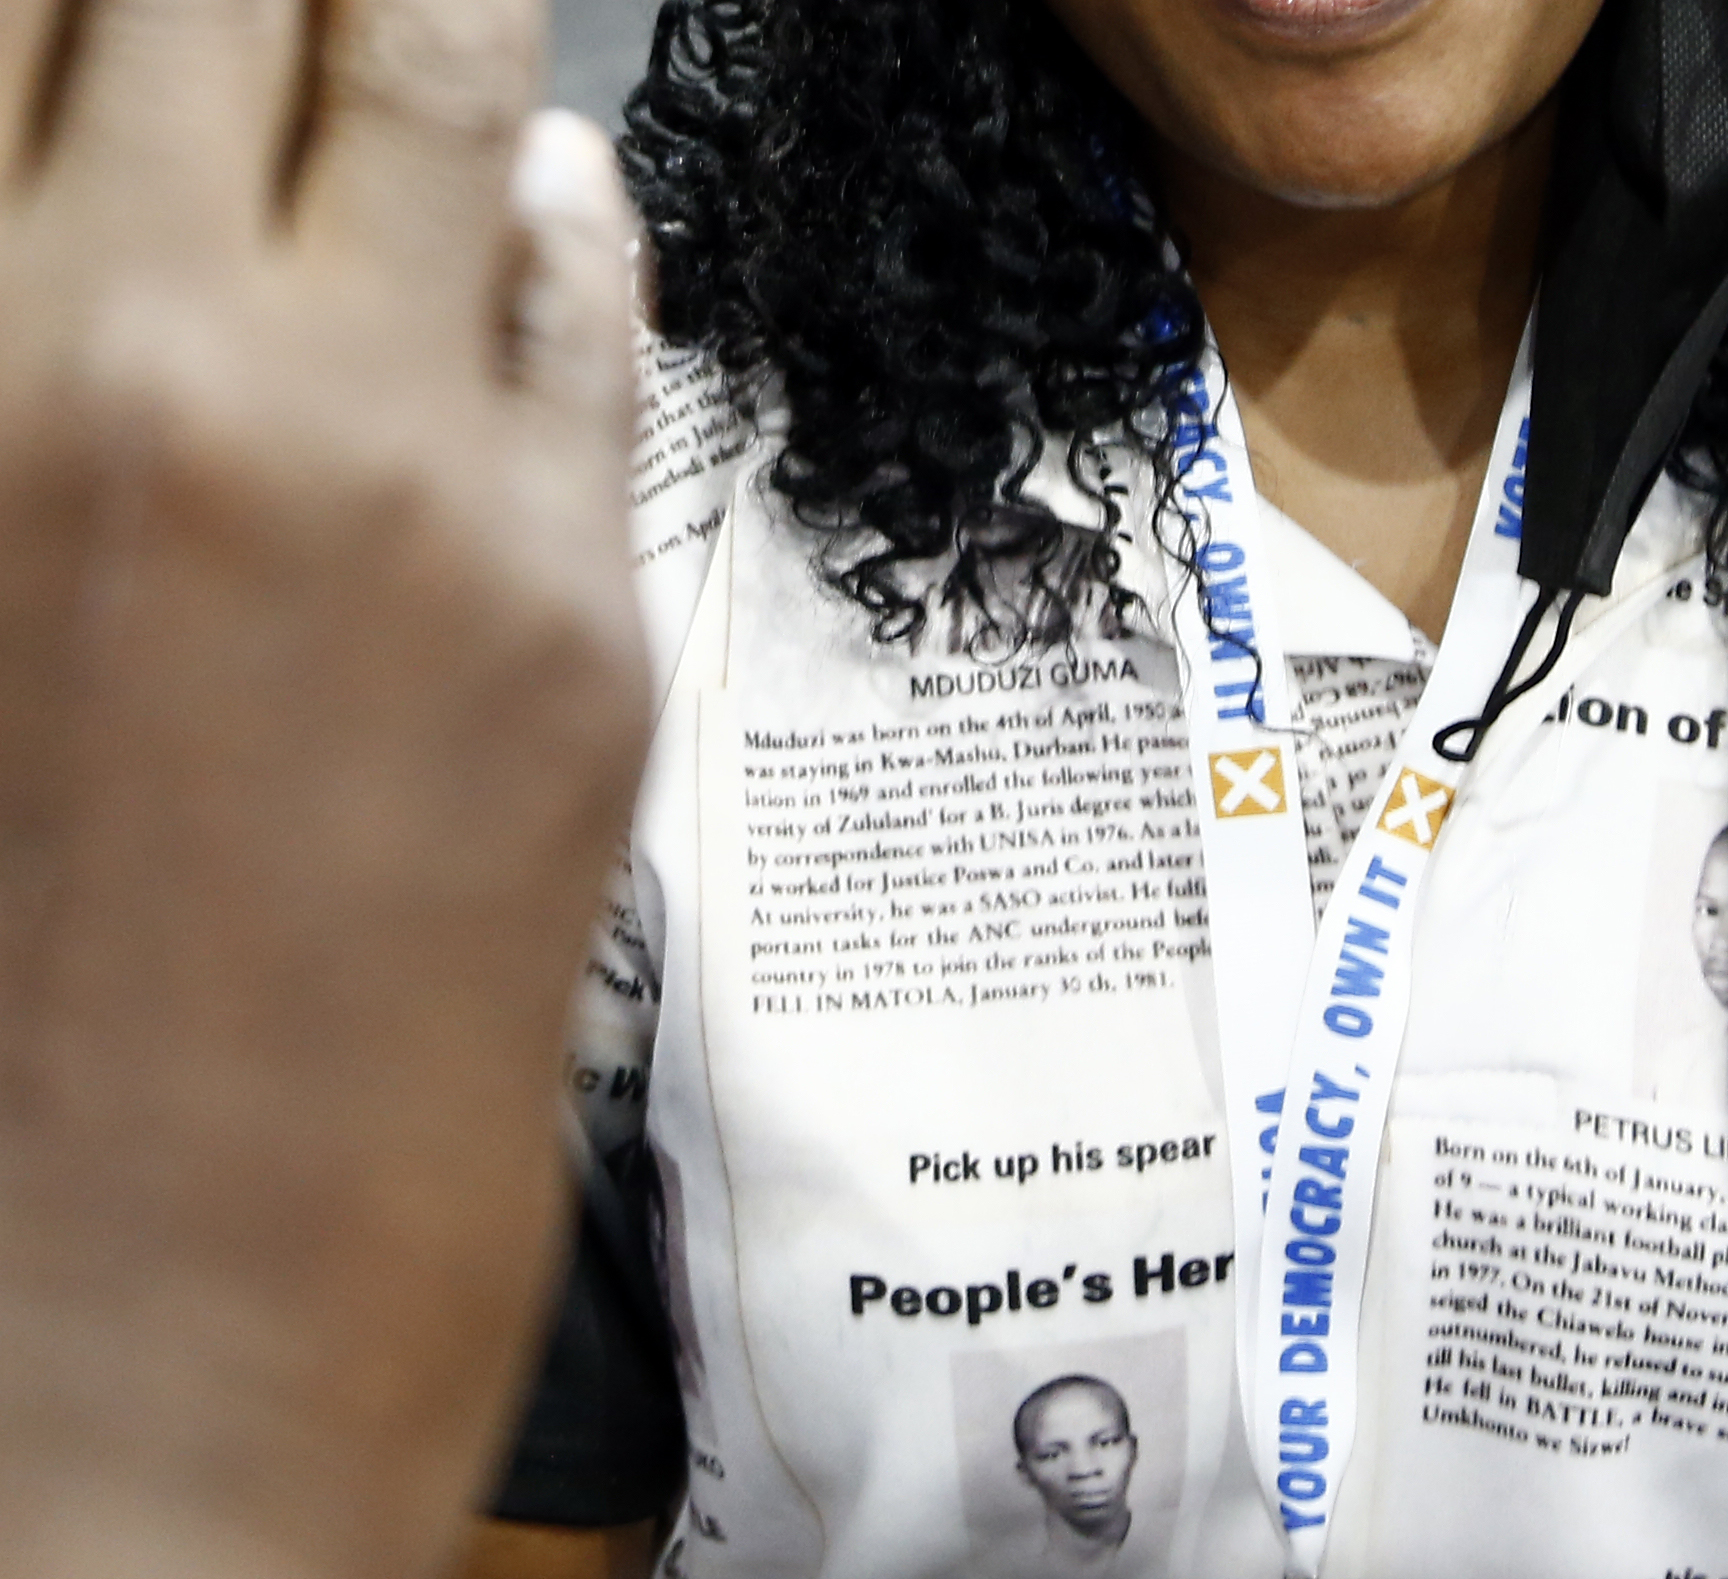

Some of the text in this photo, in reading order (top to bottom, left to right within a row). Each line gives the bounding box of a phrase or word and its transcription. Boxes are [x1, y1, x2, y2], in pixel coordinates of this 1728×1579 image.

[1194, 542, 1255, 662] OWN
[910, 659, 1139, 701] MDUDUZI GUMA
[1212, 681, 1266, 724] IT
[744, 701, 1115, 750] Mduduzi was born on the 4th of April,
[1668, 708, 1728, 750] of
[744, 732, 1131, 784] was staying in Kwa-Mashu, He
[744, 788, 795, 808] lation
[804, 789, 821, 807] in
[877, 779, 913, 801] and
[918, 772, 997, 797] enrolled
[1004, 770, 1034, 789] the
[1042, 763, 1134, 786] following
[1140, 765, 1180, 783] year
[748, 817, 807, 843] versity
[813, 815, 831, 837] of
[939, 808, 966, 826] for
[974, 809, 984, 822] a
[1017, 799, 1064, 823] Juris
[1070, 795, 1131, 817] degree
[747, 845, 767, 870] by
[774, 839, 924, 870] correspondence
[931, 833, 974, 857] with
[980, 829, 1055, 852] UNISA
[1061, 825, 1079, 845] in
[1140, 821, 1165, 840] As
[1172, 825, 1181, 838] a
[749, 876, 764, 896] zi
[771, 873, 840, 896] worked
[846, 872, 875, 892] for
[881, 868, 947, 896] Justice
[1022, 856, 1058, 878] and
[1107, 849, 1143, 871] and
[1148, 849, 1193, 868] later
[751, 906, 772, 926] At
[780, 901, 884, 926] university,
[890, 899, 913, 918] he
[921, 902, 957, 916] was
[964, 902, 973, 914] a
[979, 889, 1041, 911] SASO
[1131, 880, 1161, 901] He
[750, 909, 1166, 961] portant tasks for the ANC underground
[751, 969, 826, 988] country
[836, 963, 854, 982] in
[913, 962, 934, 976] to
[941, 954, 977, 978] join
[985, 952, 1016, 971] the
[1024, 946, 1078, 968] ranks
[1086, 944, 1105, 961] of
[1113, 940, 1144, 960] the
[817, 991, 843, 1013] IN
[851, 987, 964, 1009] MATOLA,
[970, 981, 1051, 1007] January
[1574, 1108, 1693, 1154] PETRUS
[908, 1131, 1216, 1185] Pick up his spear
[1434, 1135, 1485, 1162] Born
[1492, 1149, 1518, 1165] on
[1526, 1146, 1557, 1171] the
[1604, 1163, 1626, 1184] of
[1633, 1166, 1726, 1205] January,
[1277, 852, 1407, 1534] YOUR DEMOCRACY, OWN IT
[1434, 1169, 1454, 1188] of
[1509, 1184, 1519, 1197] a
[1527, 1182, 1595, 1210] typical
[1604, 1199, 1693, 1234] working
[1432, 1227, 1503, 1257] church
[1509, 1245, 1527, 1261] at
[1534, 1244, 1566, 1267] the
[1572, 1250, 1647, 1277] Jabavu
[1433, 1198, 1463, 1219] He
[1471, 1209, 1507, 1227] was
[1516, 1214, 1526, 1229] a
[1533, 1211, 1615, 1247] brilliant
[1624, 1229, 1705, 1262] football
[849, 1262, 1114, 1327] People's
[1431, 1260, 1449, 1280] in
[1512, 1271, 1544, 1295] On
[1552, 1279, 1585, 1302] the
[1638, 1296, 1659, 1316] of
[1497, 1299, 1527, 1320] the
[1459, 1347, 1486, 1371] his
[1574, 1343, 1598, 1366] he
[1681, 1362, 1703, 1378] to
[1424, 1376, 1452, 1396] He
[1499, 1385, 1516, 1410] in
